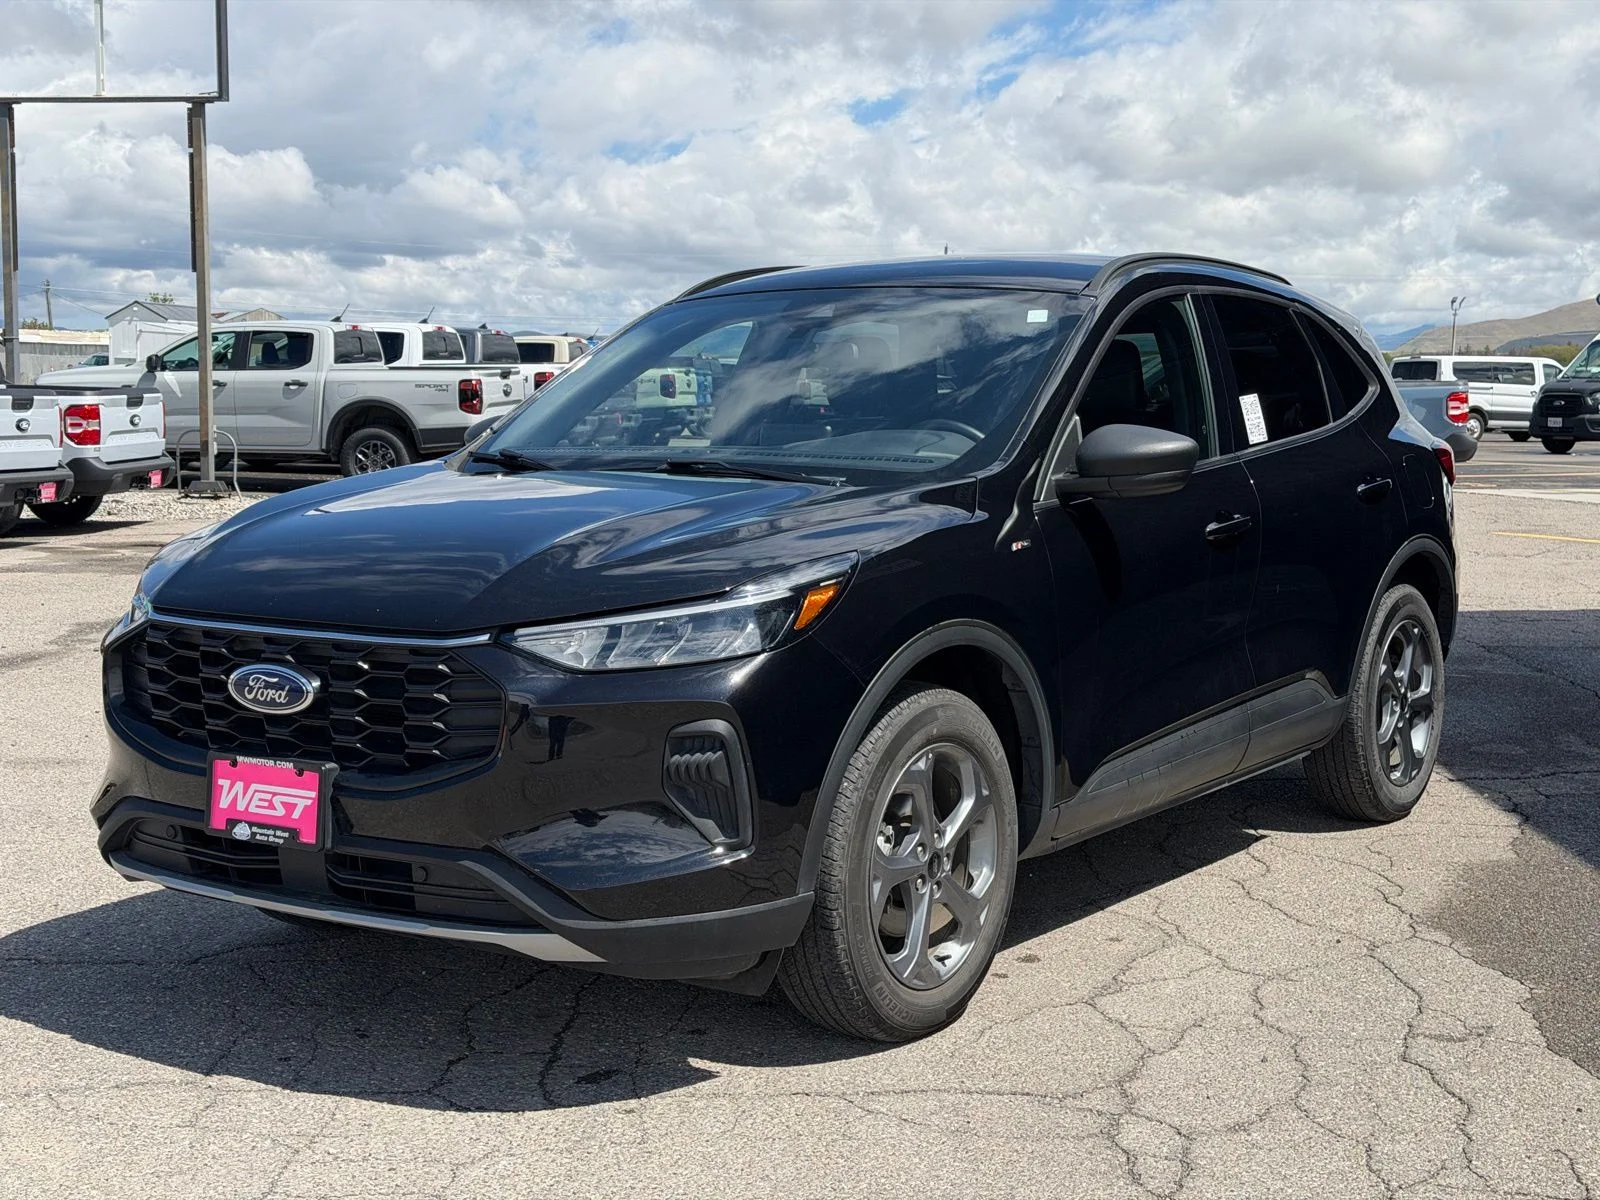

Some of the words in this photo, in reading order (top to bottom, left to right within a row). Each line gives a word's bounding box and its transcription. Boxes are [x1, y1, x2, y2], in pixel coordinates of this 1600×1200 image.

[244, 674, 290, 703] Ford
[236, 755, 294, 770] MWMOTOR.COM
[217, 778, 317, 820] WEST
[251, 826, 275, 836] Mountain
[275, 829, 290, 838] West
[255, 833, 268, 841] Auto
[268, 835, 284, 844] Group
[855, 934, 875, 980] PRIMACY
